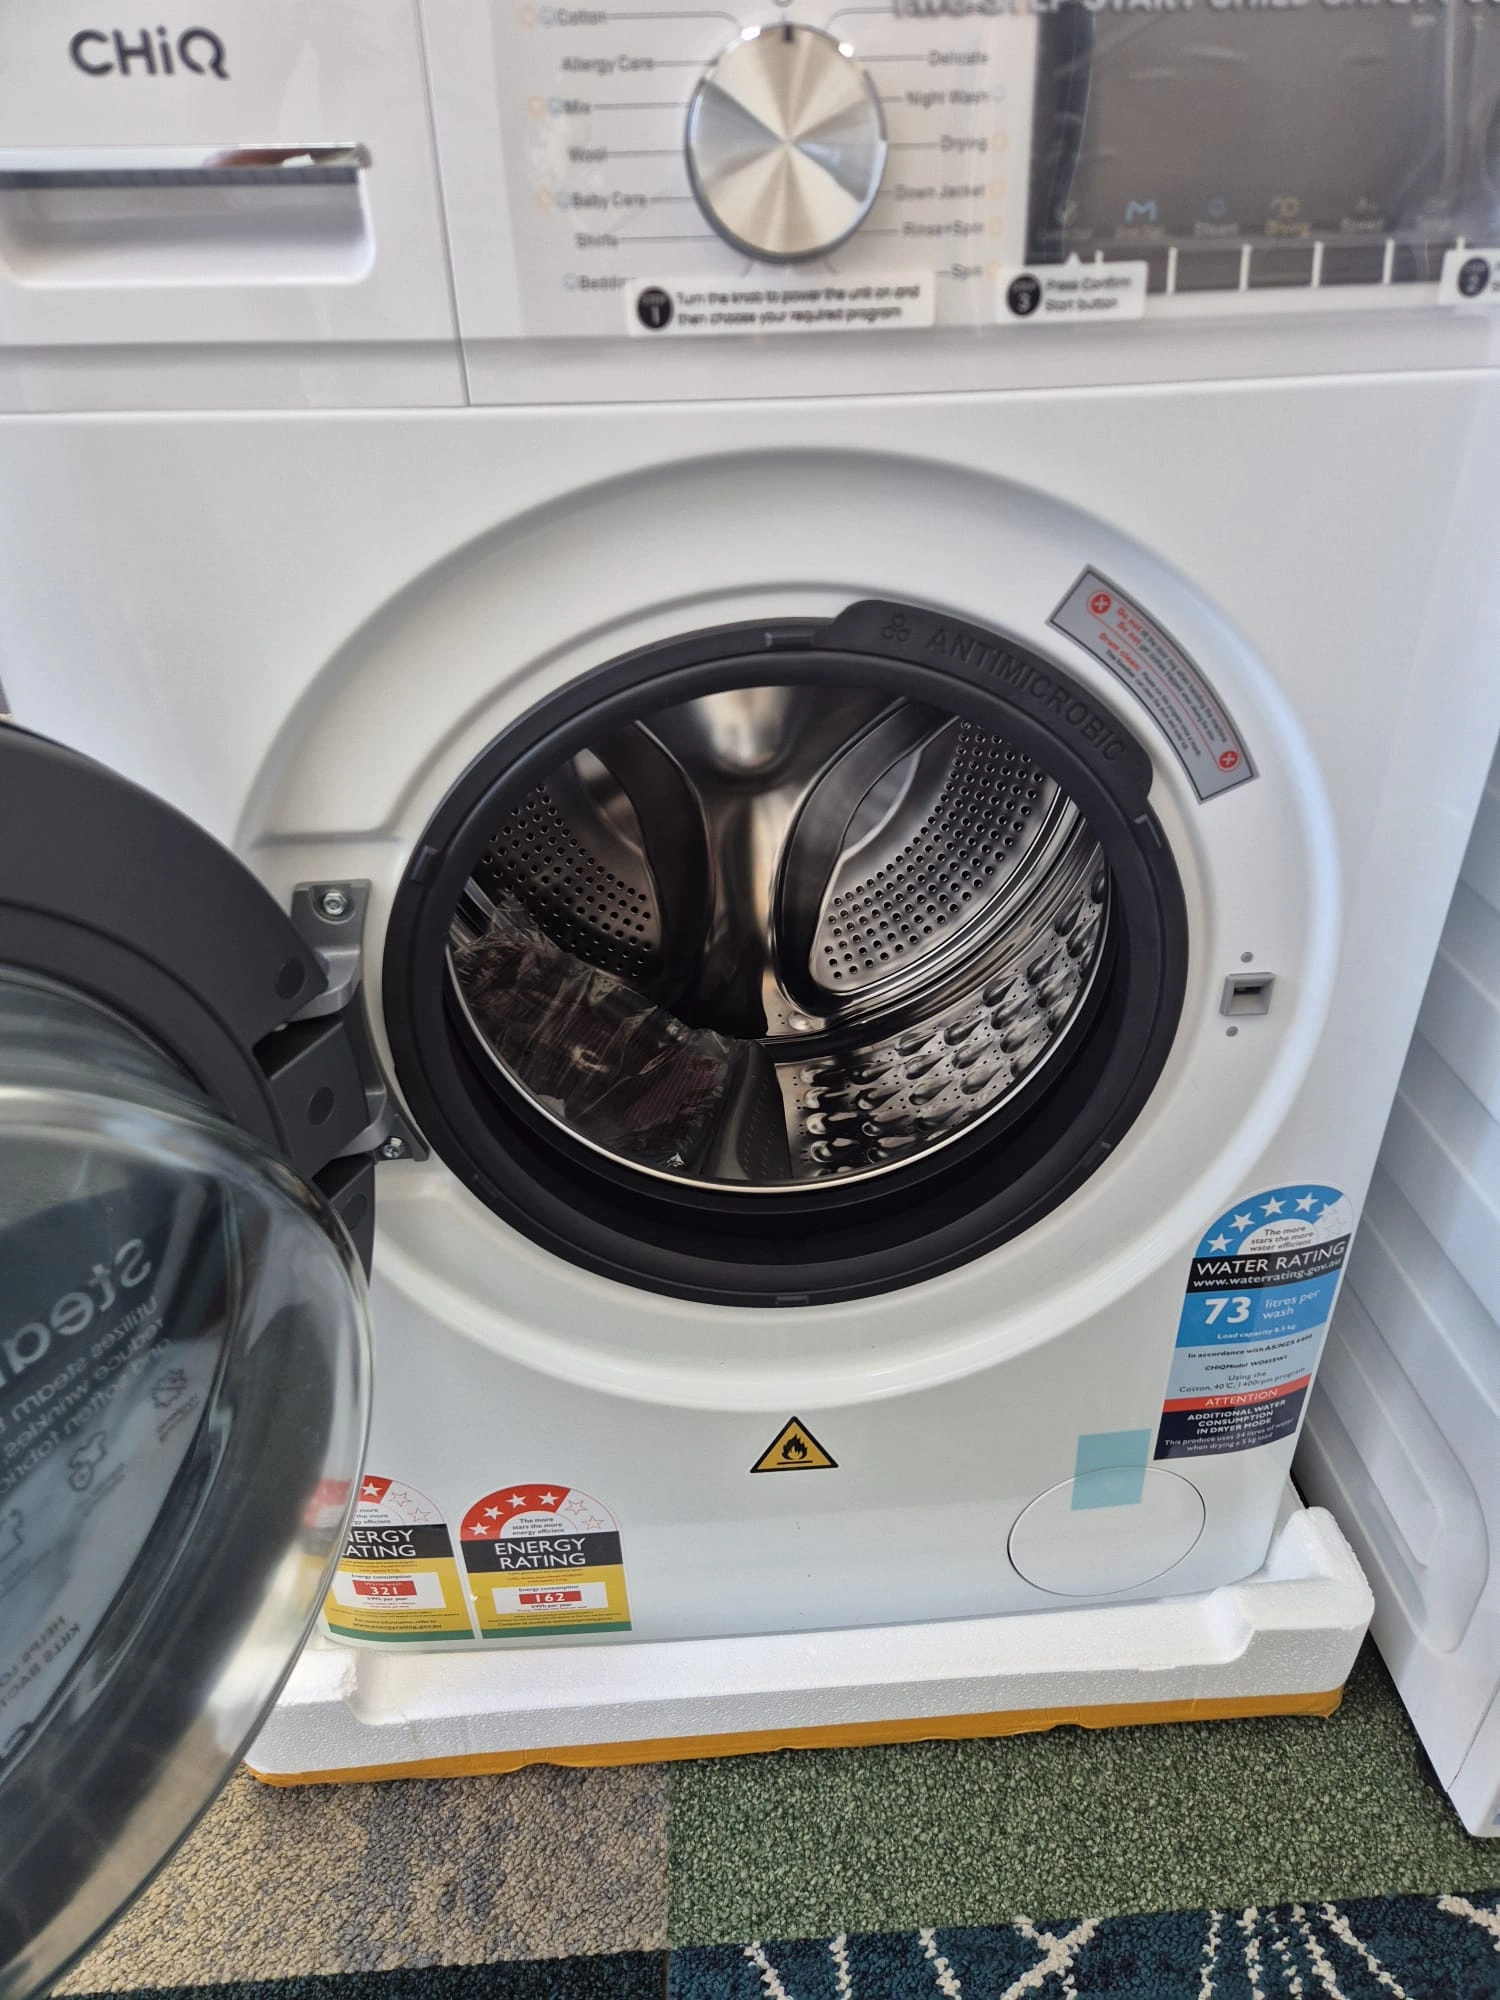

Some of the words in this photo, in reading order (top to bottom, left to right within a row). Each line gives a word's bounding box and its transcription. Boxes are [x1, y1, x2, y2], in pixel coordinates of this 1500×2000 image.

[557, 8, 607, 26] Cotton
[68, 24, 231, 81] CHiQ
[928, 50, 989, 66] Delicate
[562, 56, 615, 76] Allergy
[618, 54, 654, 72] Care
[563, 99, 591, 115] Mix
[906, 90, 945, 109] Night
[949, 89, 989, 105] Wash
[940, 135, 987, 153] Drying
[568, 147, 607, 163] Wool
[572, 191, 610, 210] Baby
[612, 190, 648, 208] Care
[896, 184, 937, 200] Down
[940, 184, 985, 199] Jacket
[951, 263, 982, 281] Spin
[1046, 279, 1078, 292] Press
[1081, 277, 1131, 291] Confirm
[676, 291, 705, 306] Turn
[708, 291, 729, 304] the
[732, 291, 763, 304] knob
[766, 290, 780, 303] to
[782, 288, 821, 304] power
[824, 286, 845, 301] the
[847, 286, 872, 299] unit
[875, 286, 891, 298] on
[894, 285, 921, 299] and
[1045, 299, 1074, 312] Start
[1077, 298, 1118, 312] button
[678, 313, 706, 326] then
[710, 312, 756, 326] choose
[760, 311, 787, 326] your
[791, 308, 844, 324] required
[846, 305, 902, 325] program
[1115, 608, 1129, 619] Do
[1128, 618, 1142, 631] not
[1098, 633, 1120, 651] Drum
[1116, 622, 1129, 633] Do
[1128, 632, 1142, 644] not
[927, 627, 1127, 763] ANTIMICROBIC
[1275, 1235, 1290, 1243] the
[1292, 1232, 1314, 1240] more
[1277, 1239, 1312, 1250] efficient
[1197, 1259, 1269, 1276] WATER
[1275, 1240, 1346, 1270] RATING
[1193, 1258, 1342, 1288] www.waterrating.gov.au
[1265, 1297, 1298, 1309] litres
[1299, 1289, 1321, 1304] per
[1204, 1296, 1251, 1325] 73
[1262, 1307, 1294, 1320] wash
[1217, 1331, 1238, 1339] Load
[1240, 1329, 1273, 1339] capacity
[1287, 1324, 1297, 1332] kg
[1198, 1350, 1245, 1359] accordance
[1246, 1346, 1264, 1354] with
[1179, 1384, 1213, 1393] Cotton,
[1274, 1367, 1306, 1382] program
[1205, 1389, 1278, 1407] ATTENTION
[1187, 1408, 1251, 1421] ADDITIONAL
[1251, 1400, 1286, 1412] WATER
[1198, 1410, 1274, 1427] CONSUMPTION
[1210, 1425, 1242, 1434] DRYER
[1243, 1418, 1272, 1429] MODE
[1247, 1427, 1265, 1437] litres
[1275, 1418, 1295, 1428] water
[1210, 1441, 1234, 1450] drying
[1258, 1432, 1273, 1440] load
[494, 1537, 586, 1555] ENERGY
[500, 1552, 586, 1569] RATING
[370, 1587, 398, 1595] 321
[535, 1593, 565, 1603] 162
